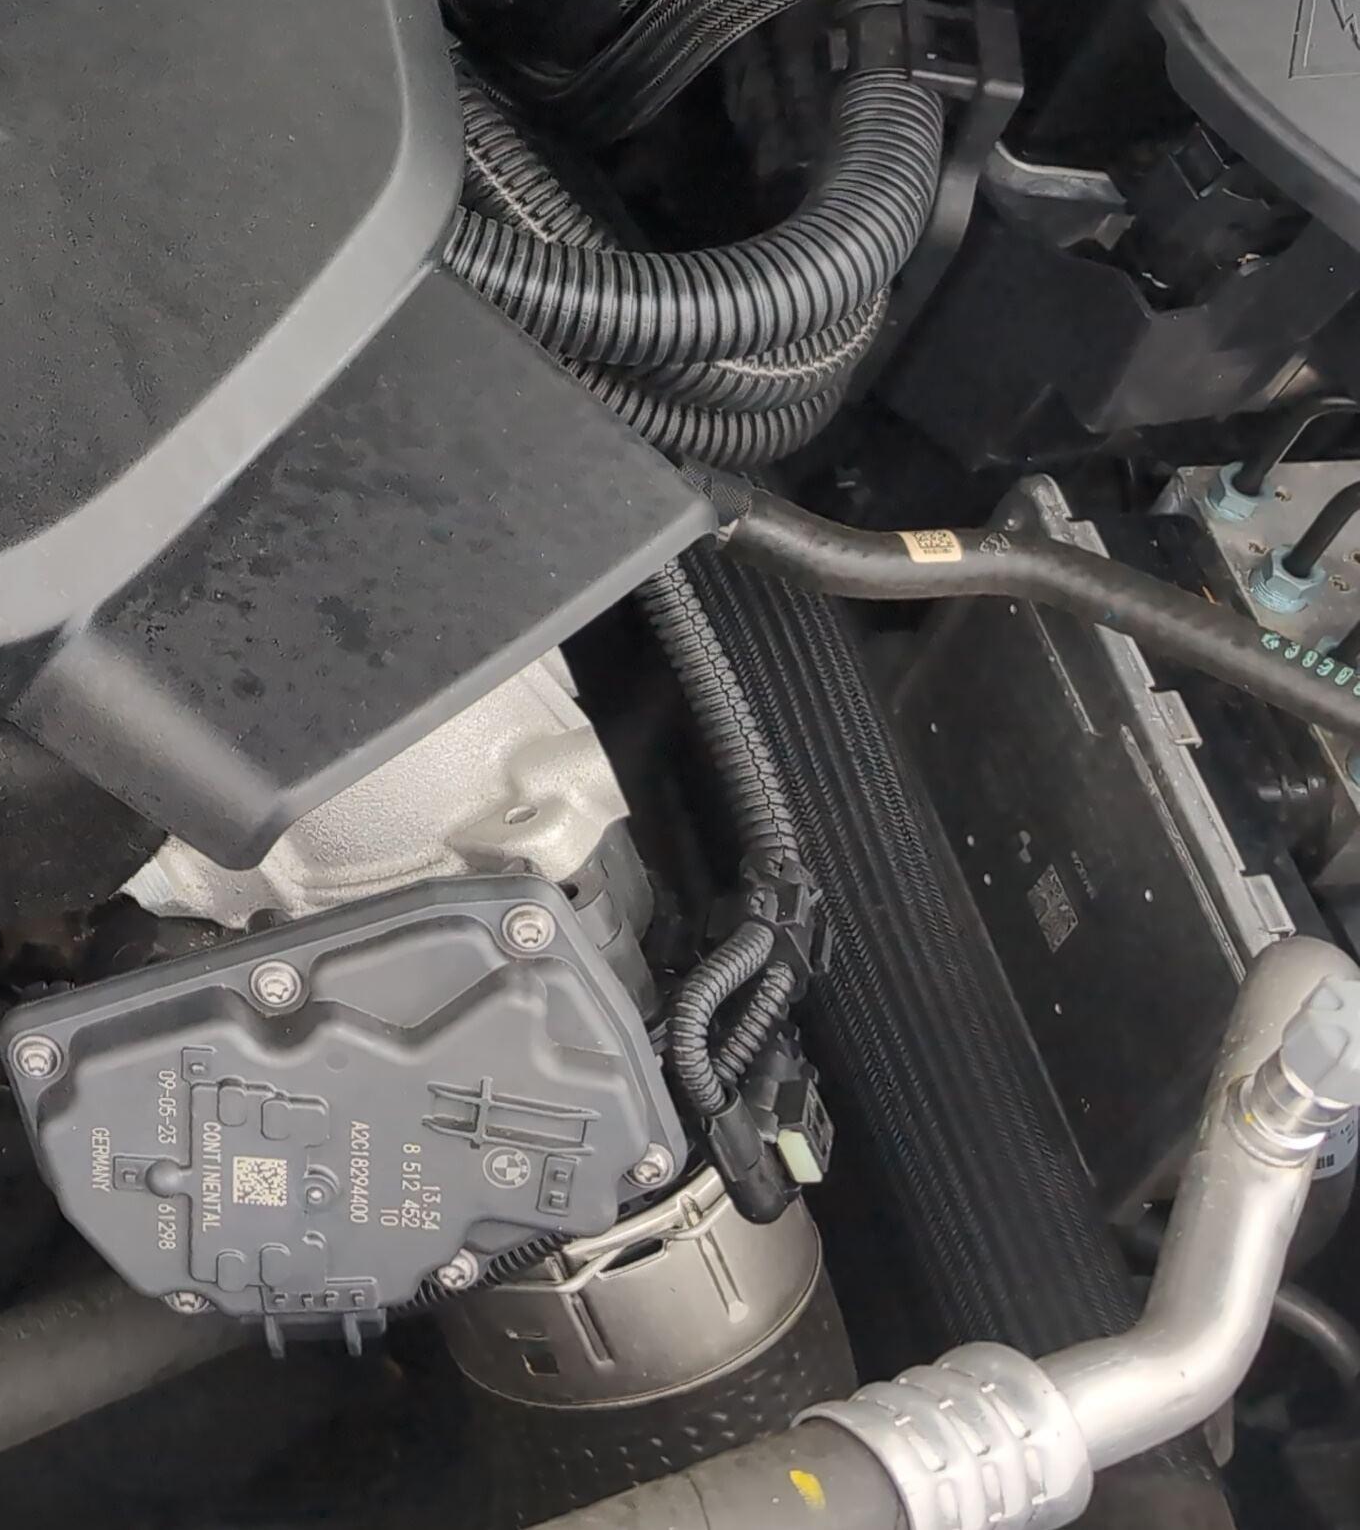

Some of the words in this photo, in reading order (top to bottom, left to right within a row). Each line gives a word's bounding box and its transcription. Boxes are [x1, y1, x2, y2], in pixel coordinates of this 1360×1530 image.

[157, 1069, 177, 1145] 09-05-23
[91, 1126, 111, 1193] GERMANY
[349, 1120, 371, 1224] A2C18294400
[402, 1142, 422, 1155] 8
[201, 1120, 222, 1233] CONTINENTAL
[402, 1160, 422, 1192] 512
[157, 1202, 177, 1250] 61298
[380, 1207, 400, 1228] 10
[401, 1198, 421, 1229] 452
[421, 1185, 442, 1231] 13.54
